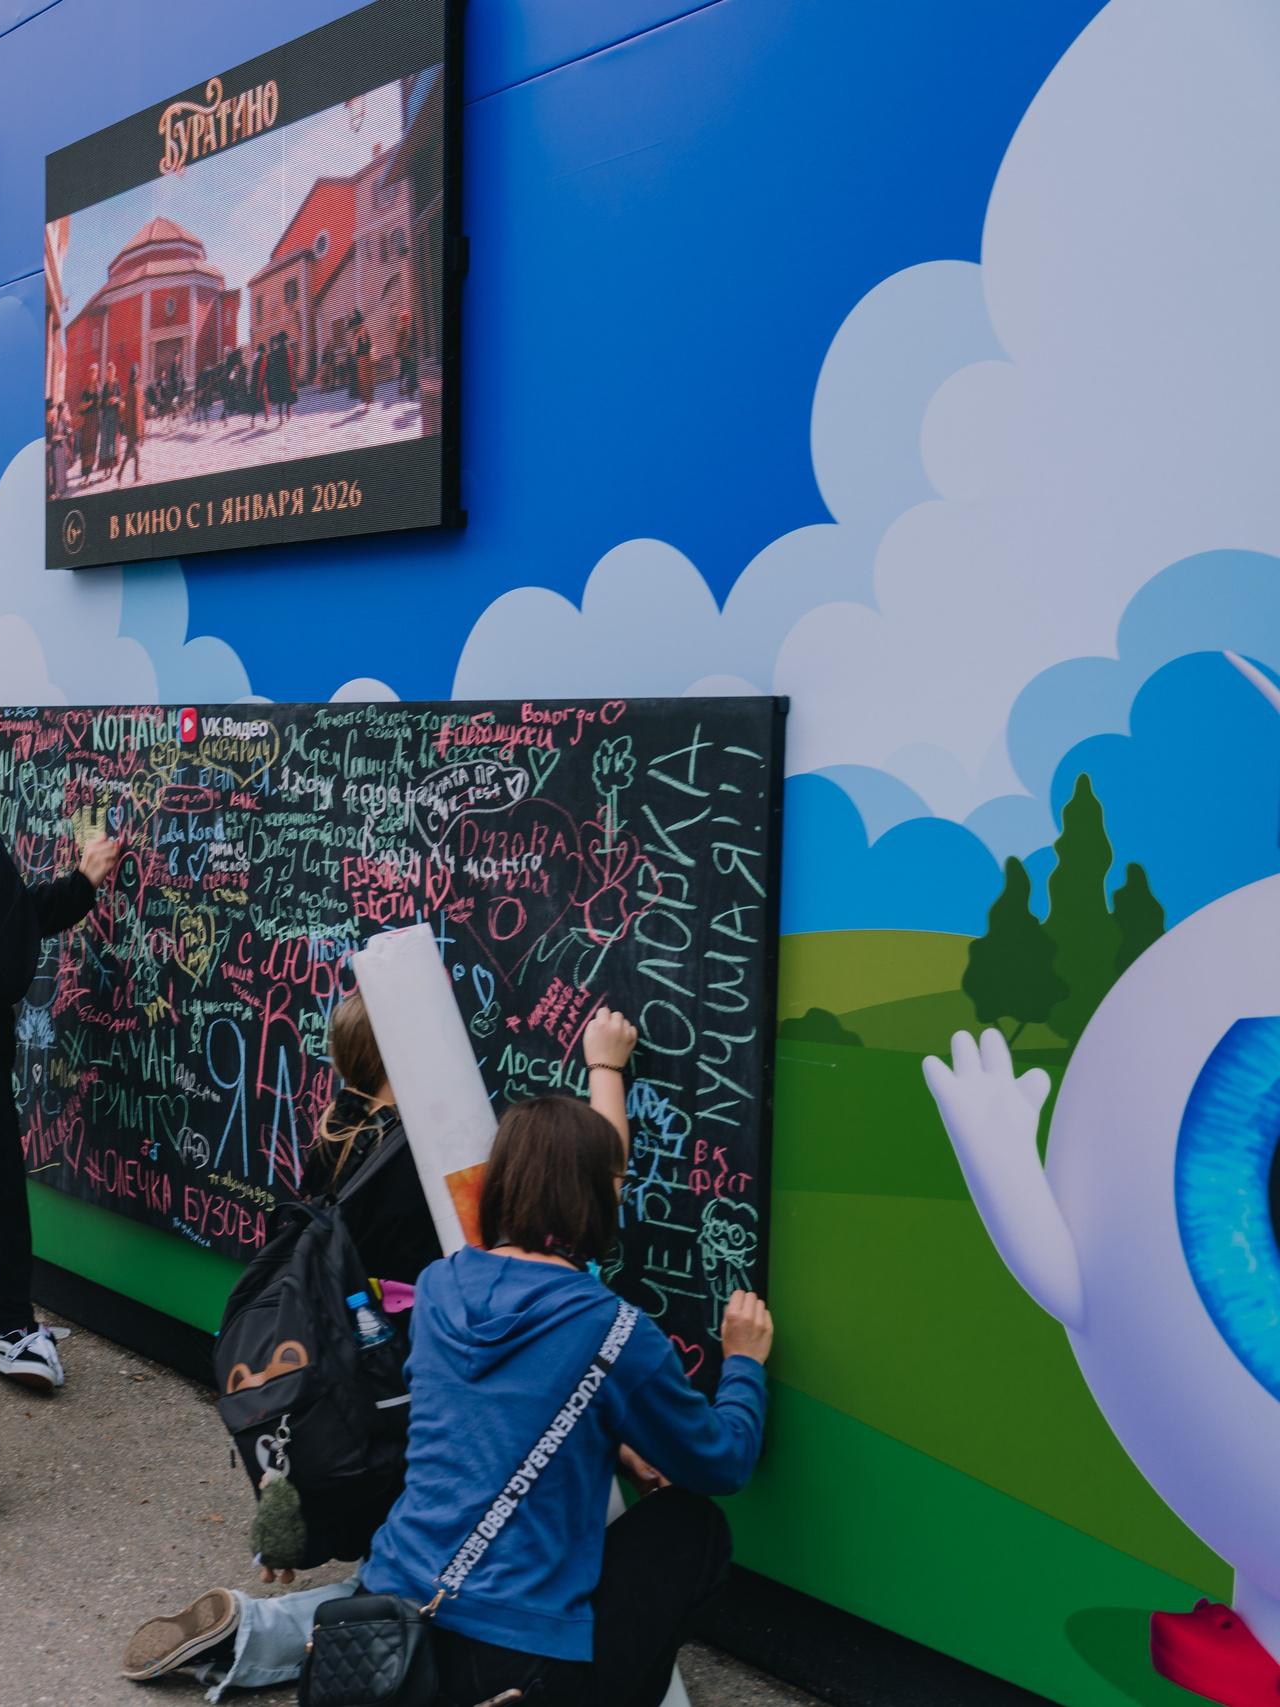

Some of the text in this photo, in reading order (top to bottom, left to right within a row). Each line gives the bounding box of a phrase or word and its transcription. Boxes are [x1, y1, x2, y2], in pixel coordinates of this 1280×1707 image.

[158, 76, 279, 179] БУРАТИНО
[109, 479, 362, 539] В КИНО С 1 ЯНВАРЯ 2026
[201, 716, 269, 740] VK Видео
[521, 702, 597, 746] Вологда
[260, 935, 358, 997] ЛЮБО
[185, 1184, 266, 1249] БУЗОВА
[476, 1363, 607, 1541] KUCHEN&BAG.1980
